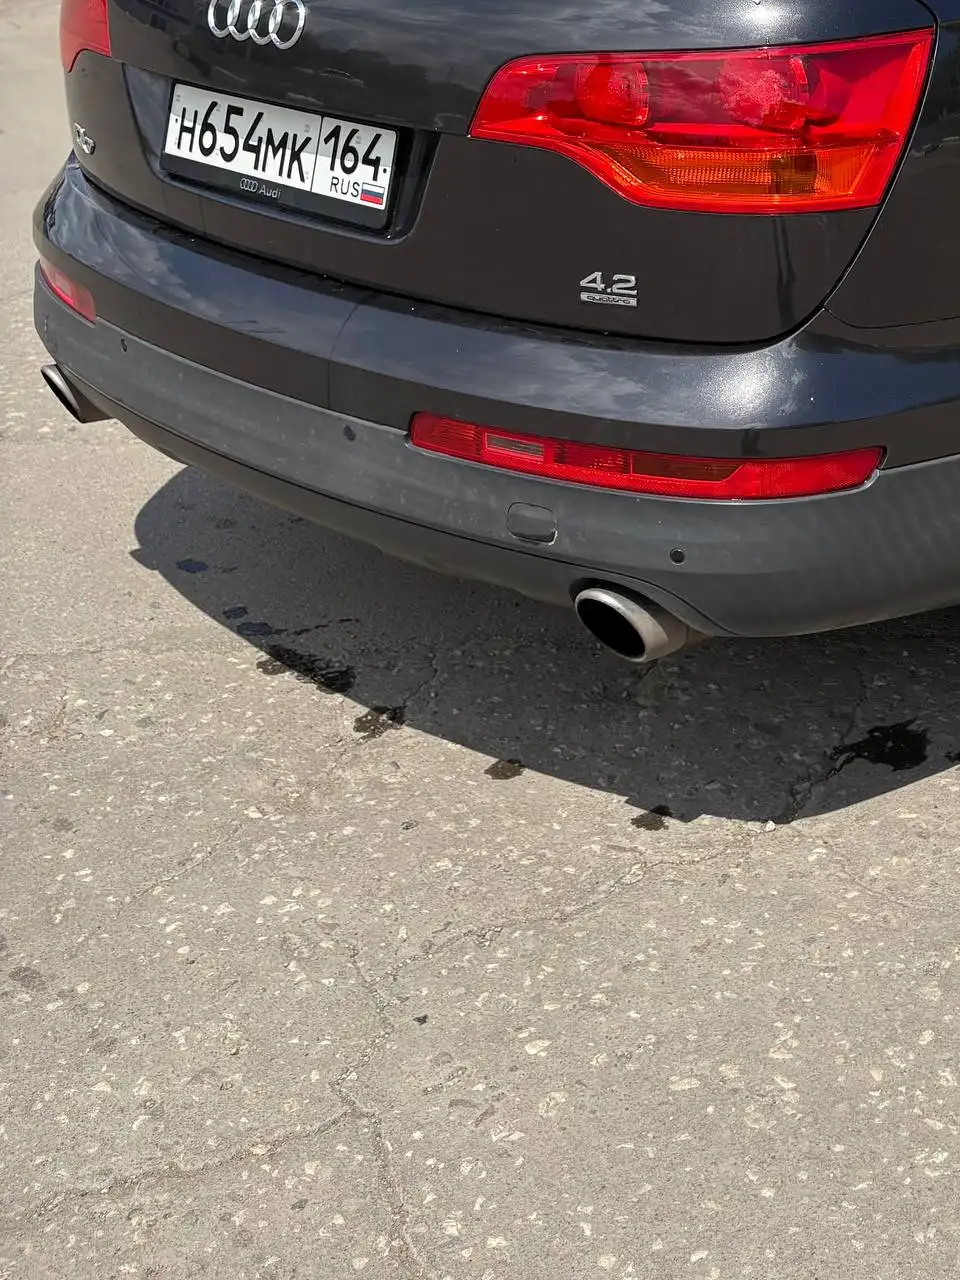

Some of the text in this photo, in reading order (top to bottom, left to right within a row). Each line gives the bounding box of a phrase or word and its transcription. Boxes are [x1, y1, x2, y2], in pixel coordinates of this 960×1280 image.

[323, 123, 384, 182] 164
[259, 184, 282, 199] Audi
[329, 175, 360, 198] RUS
[580, 271, 637, 295] 4.2
